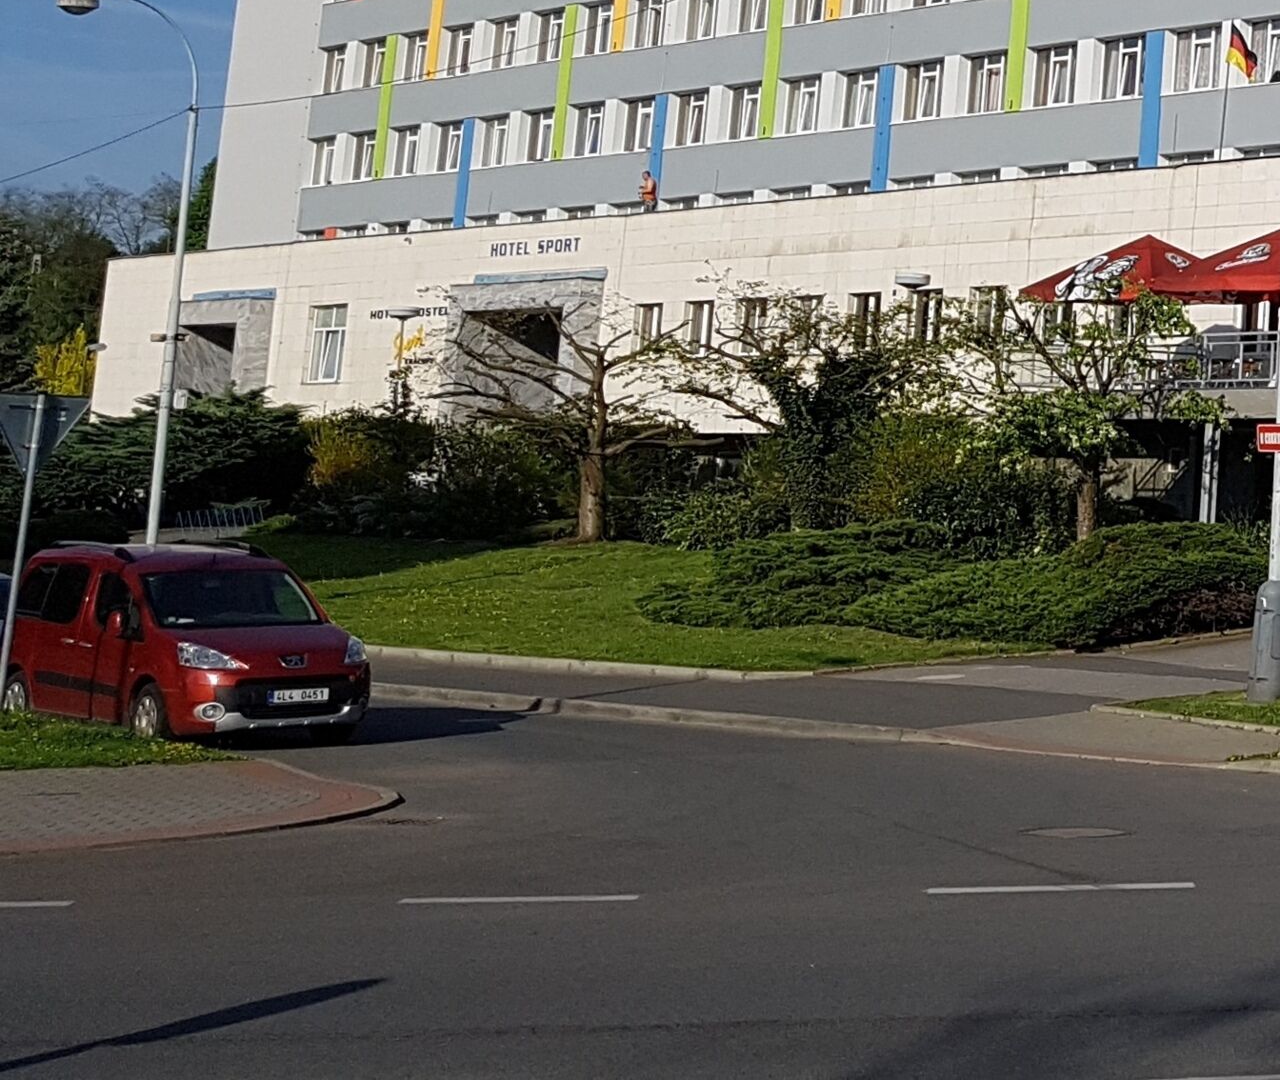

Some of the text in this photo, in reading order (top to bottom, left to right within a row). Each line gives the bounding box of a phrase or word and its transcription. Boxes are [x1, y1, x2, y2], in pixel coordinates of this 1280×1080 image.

[490, 237, 581, 257] HOTEL SPORT
[418, 306, 448, 317] OSTEL
